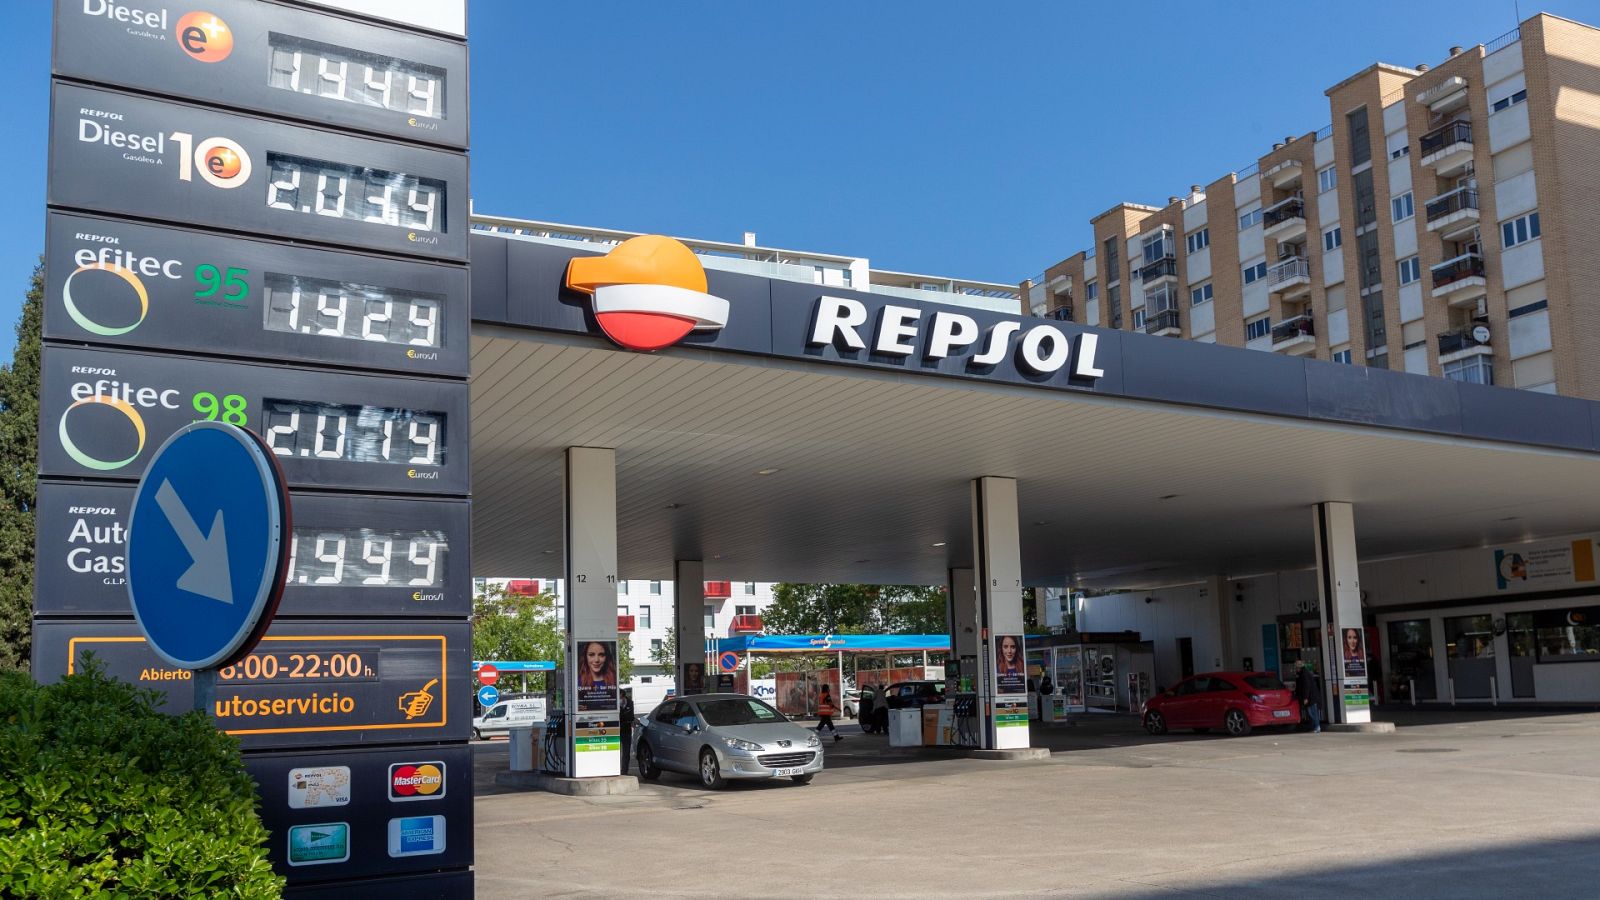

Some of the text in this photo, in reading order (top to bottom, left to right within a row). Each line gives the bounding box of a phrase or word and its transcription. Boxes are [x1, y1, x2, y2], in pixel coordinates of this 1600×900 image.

[80, 107, 124, 121] REPSOL
[79, 119, 252, 189] Diesel 10
[75, 232, 120, 244] REPSOL
[75, 247, 250, 301] efitec 95
[289, 288, 437, 346] 1.929
[811, 295, 1104, 379] REPSOL
[72, 366, 117, 376] REPSOL
[70, 380, 247, 426] efitec 98
[267, 406, 437, 465] 2.019
[68, 506, 116, 515] REPSOL
[67, 547, 125, 574] Gas
[576, 574, 587, 583] 12
[607, 575, 615, 583] 11
[140, 668, 191, 681] Abierto
[215, 693, 354, 718] utoservicio
[394, 775, 440, 786] MasterCard
